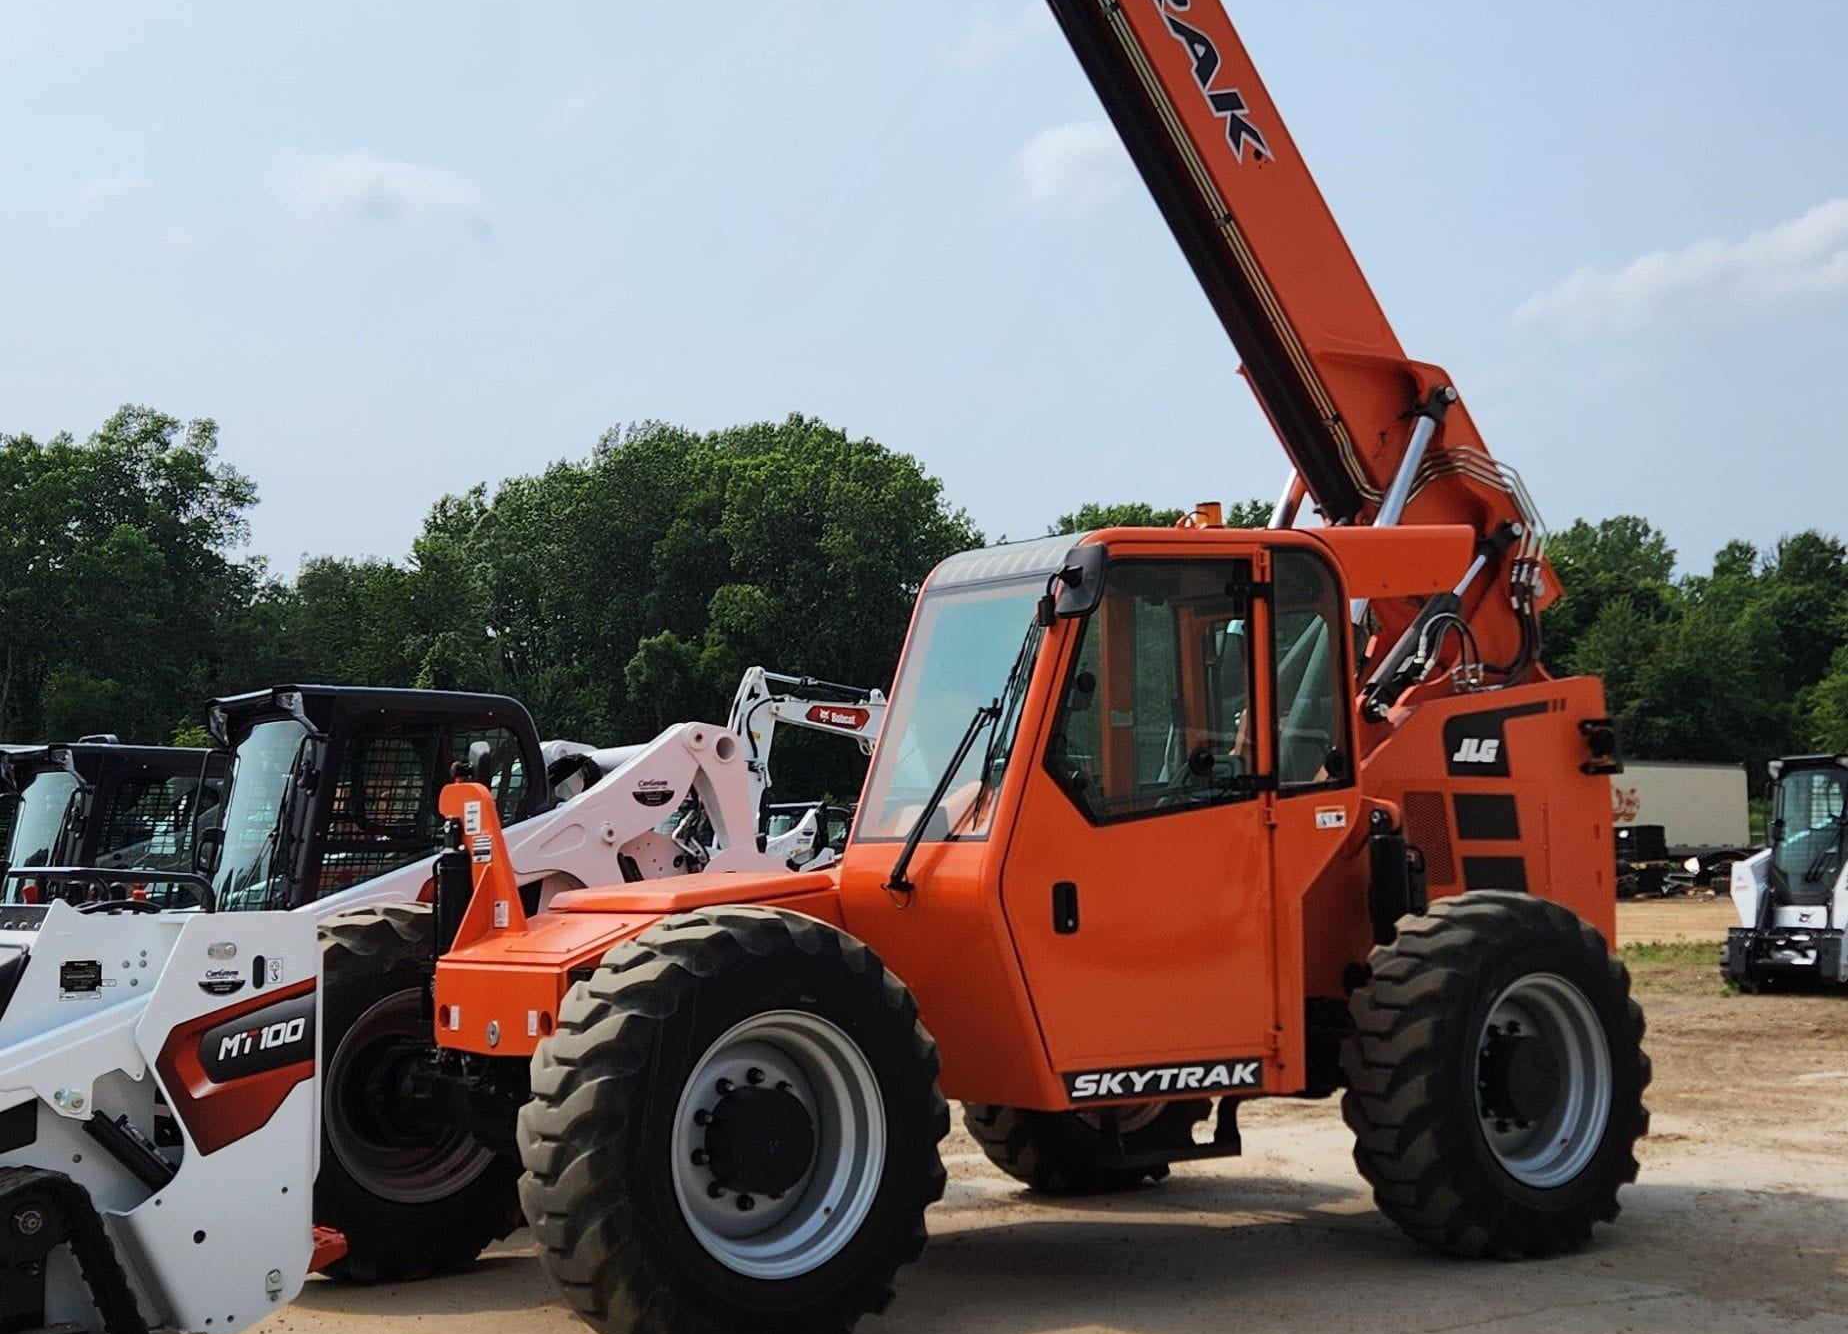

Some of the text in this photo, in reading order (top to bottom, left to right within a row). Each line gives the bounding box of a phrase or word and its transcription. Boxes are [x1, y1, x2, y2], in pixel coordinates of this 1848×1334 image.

[831, 712, 856, 725] Bobcat
[1452, 738, 1499, 763] JLG
[1071, 1062, 1259, 1097] SKYTRAK
